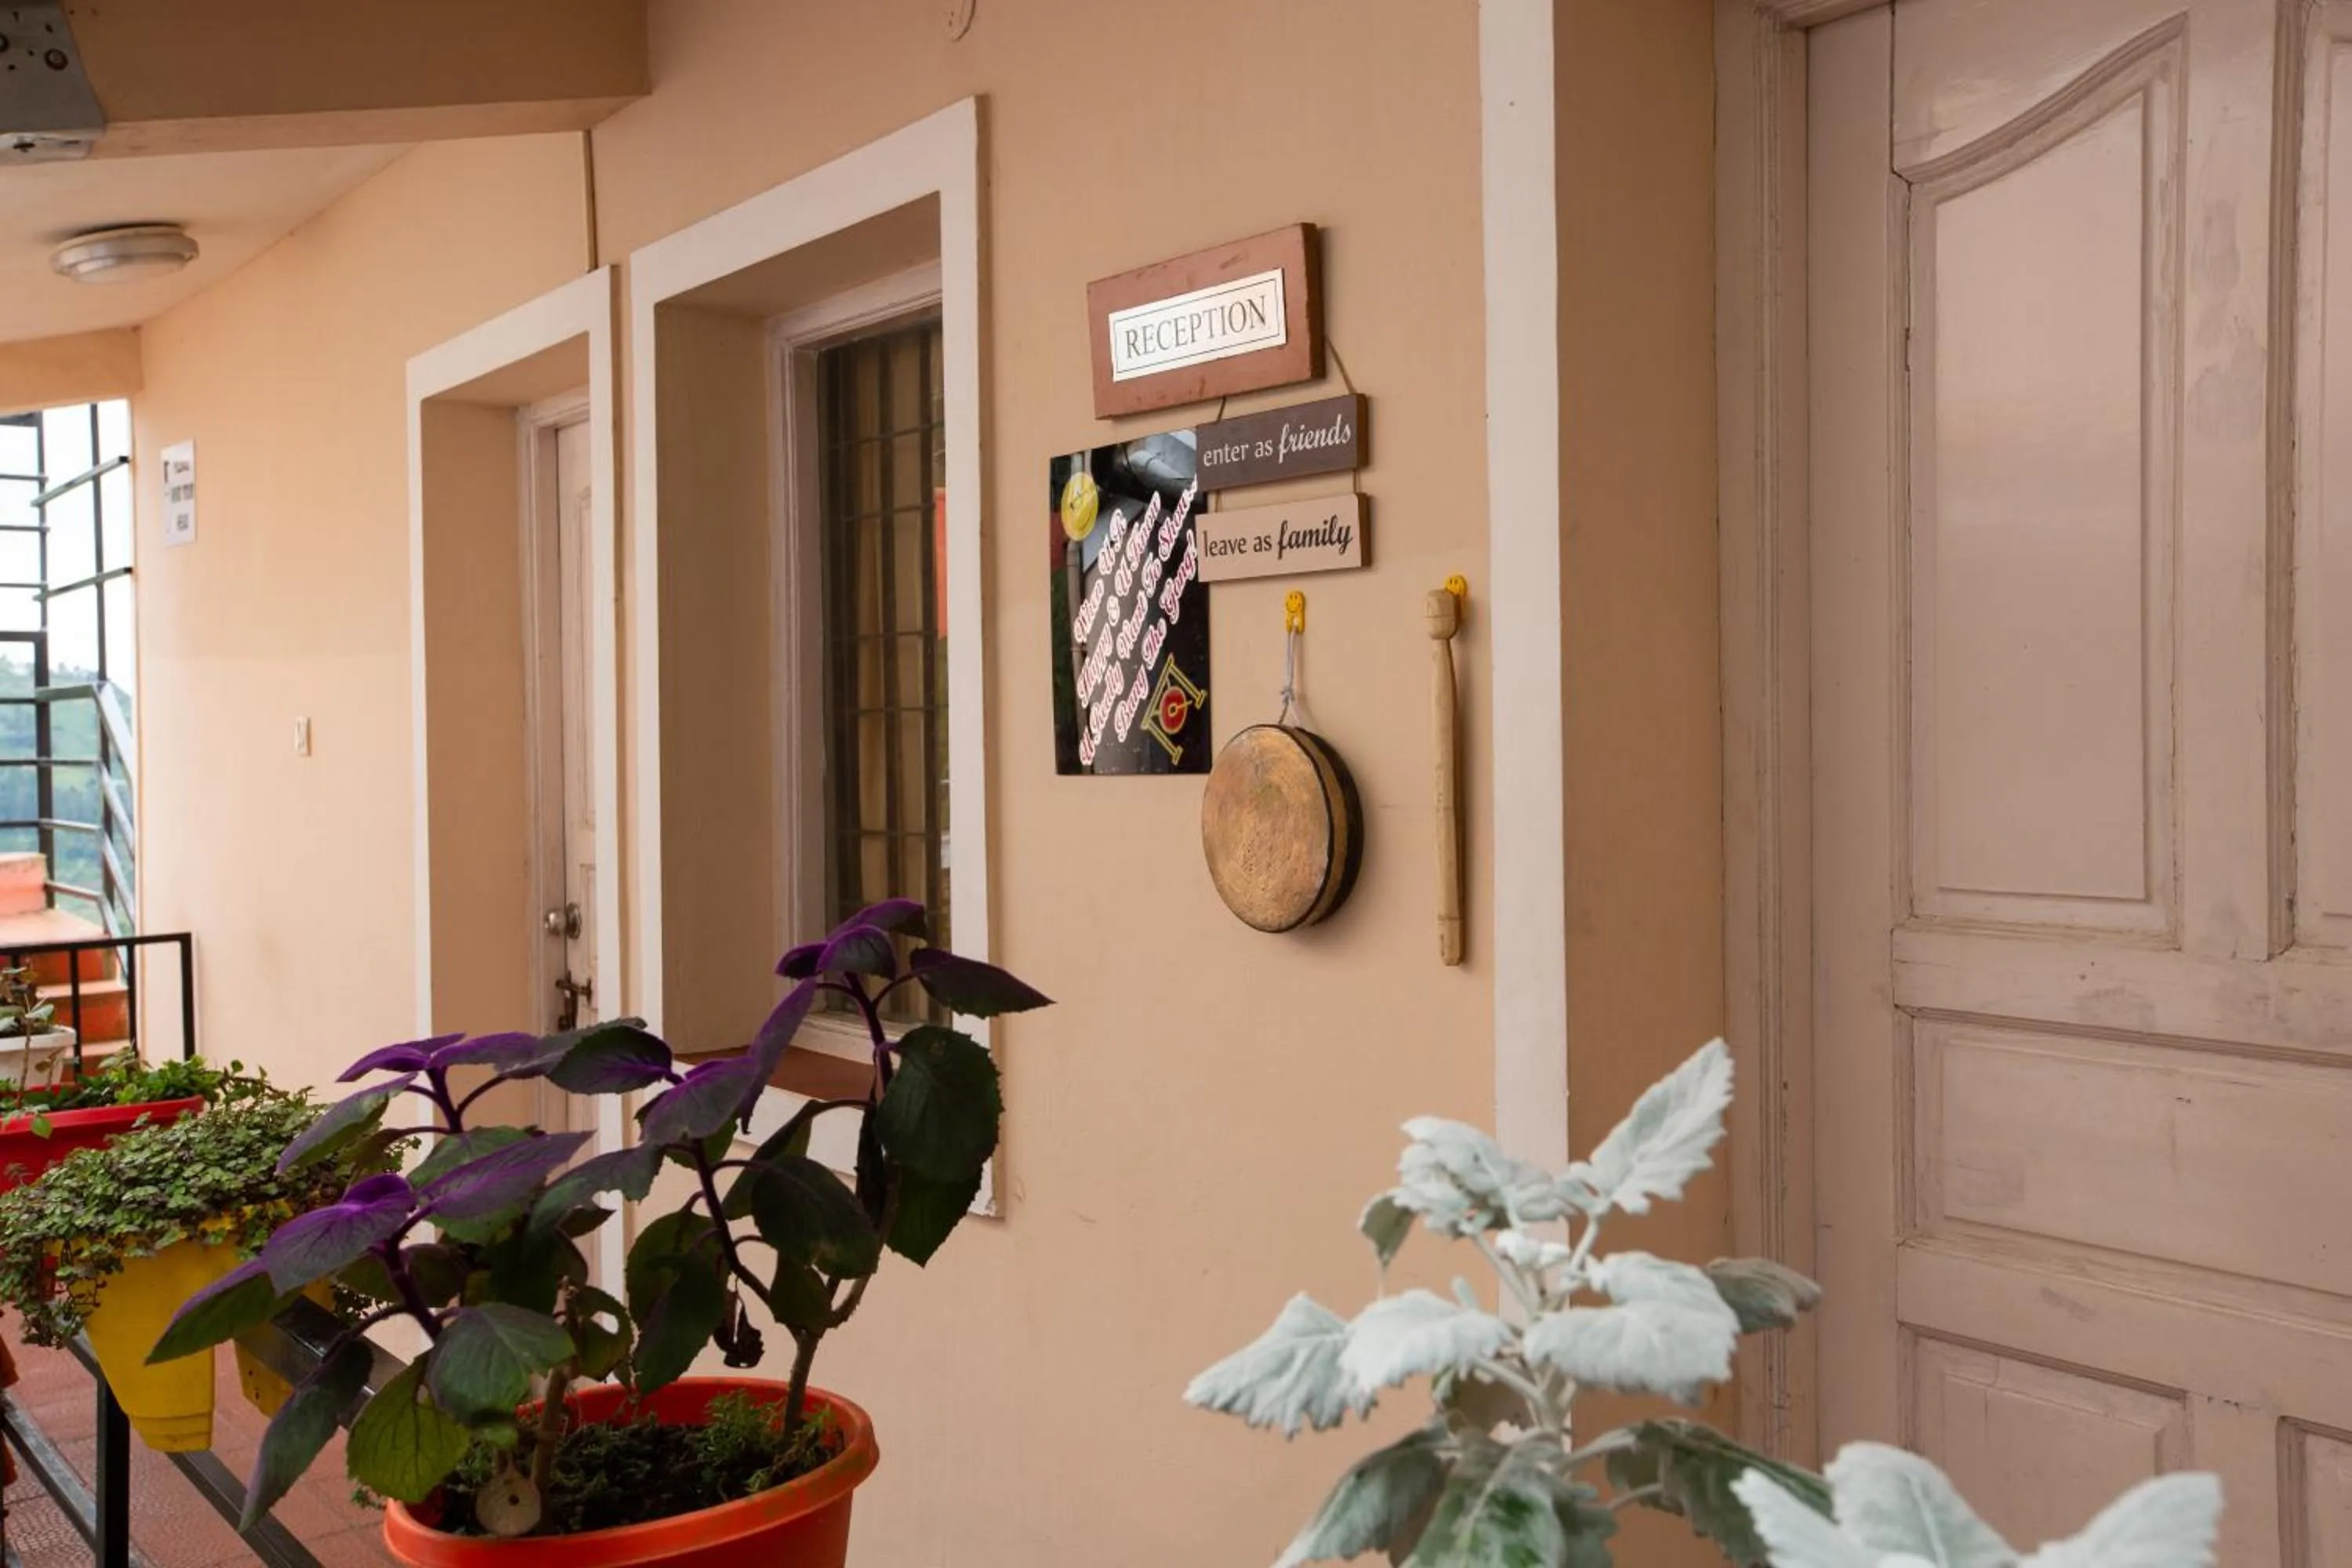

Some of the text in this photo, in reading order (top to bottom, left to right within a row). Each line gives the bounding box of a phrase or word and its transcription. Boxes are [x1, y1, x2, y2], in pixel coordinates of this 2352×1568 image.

[1125, 295, 1266, 358] RECEPTION
[1203, 414, 1351, 466] enter as friends
[1203, 514, 1353, 560] leave as family
[1076, 622, 1113, 710] Happy
[1090, 660, 1123, 745] Really
[1114, 663, 1149, 743] Bang
[1142, 618, 1167, 670] The
